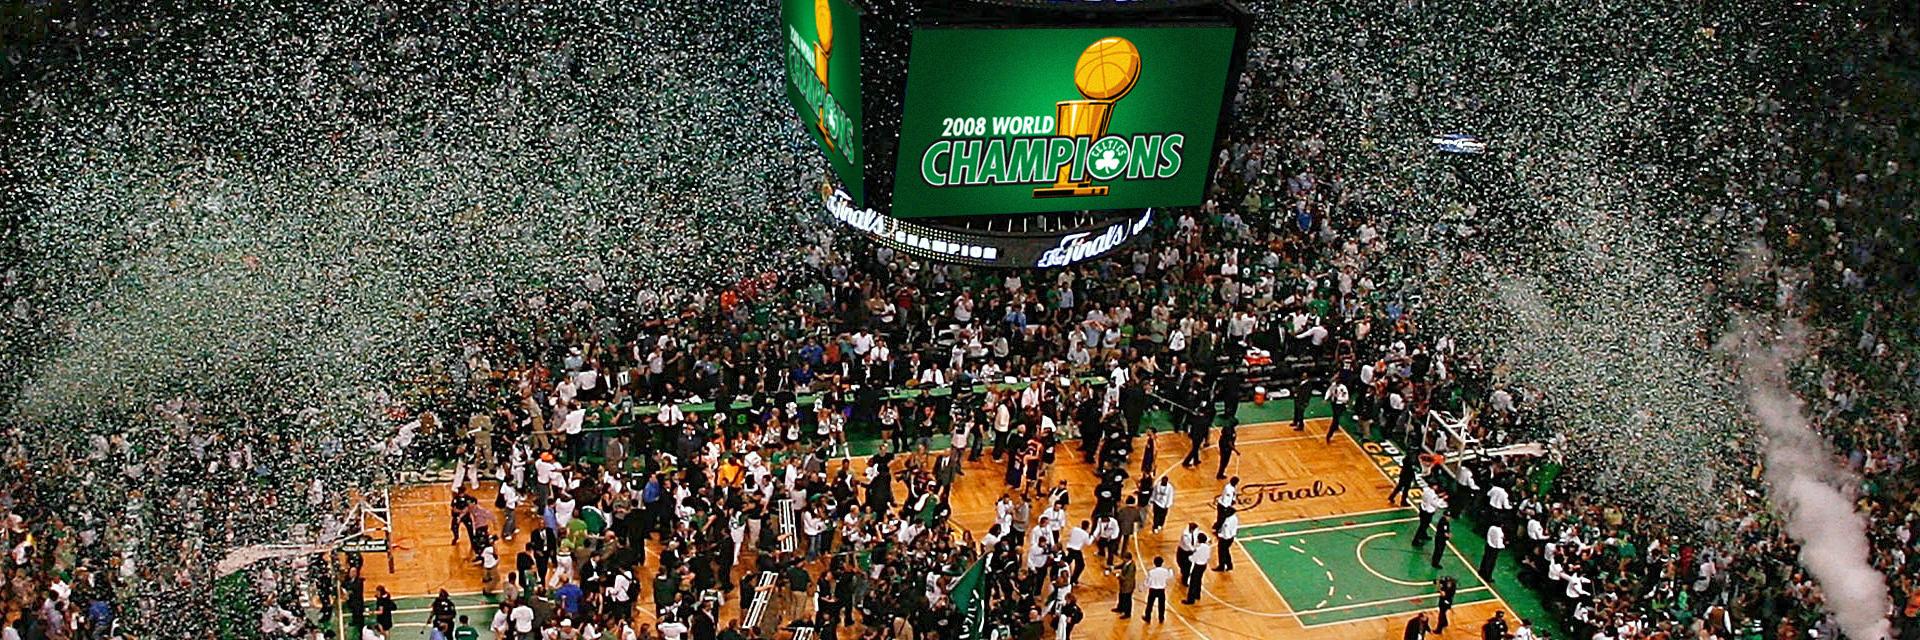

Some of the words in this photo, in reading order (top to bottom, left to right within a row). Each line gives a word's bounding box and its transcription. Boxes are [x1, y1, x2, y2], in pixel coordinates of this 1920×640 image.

[942, 117, 986, 137] 2008
[992, 115, 1054, 135] WORLD
[921, 133, 1185, 187] CHAMPIONS
[1091, 140, 1127, 157] CELTICS
[894, 231, 997, 260] CHAMPION
[1059, 224, 1124, 266] Finals
[1236, 480, 1346, 512] Finals
